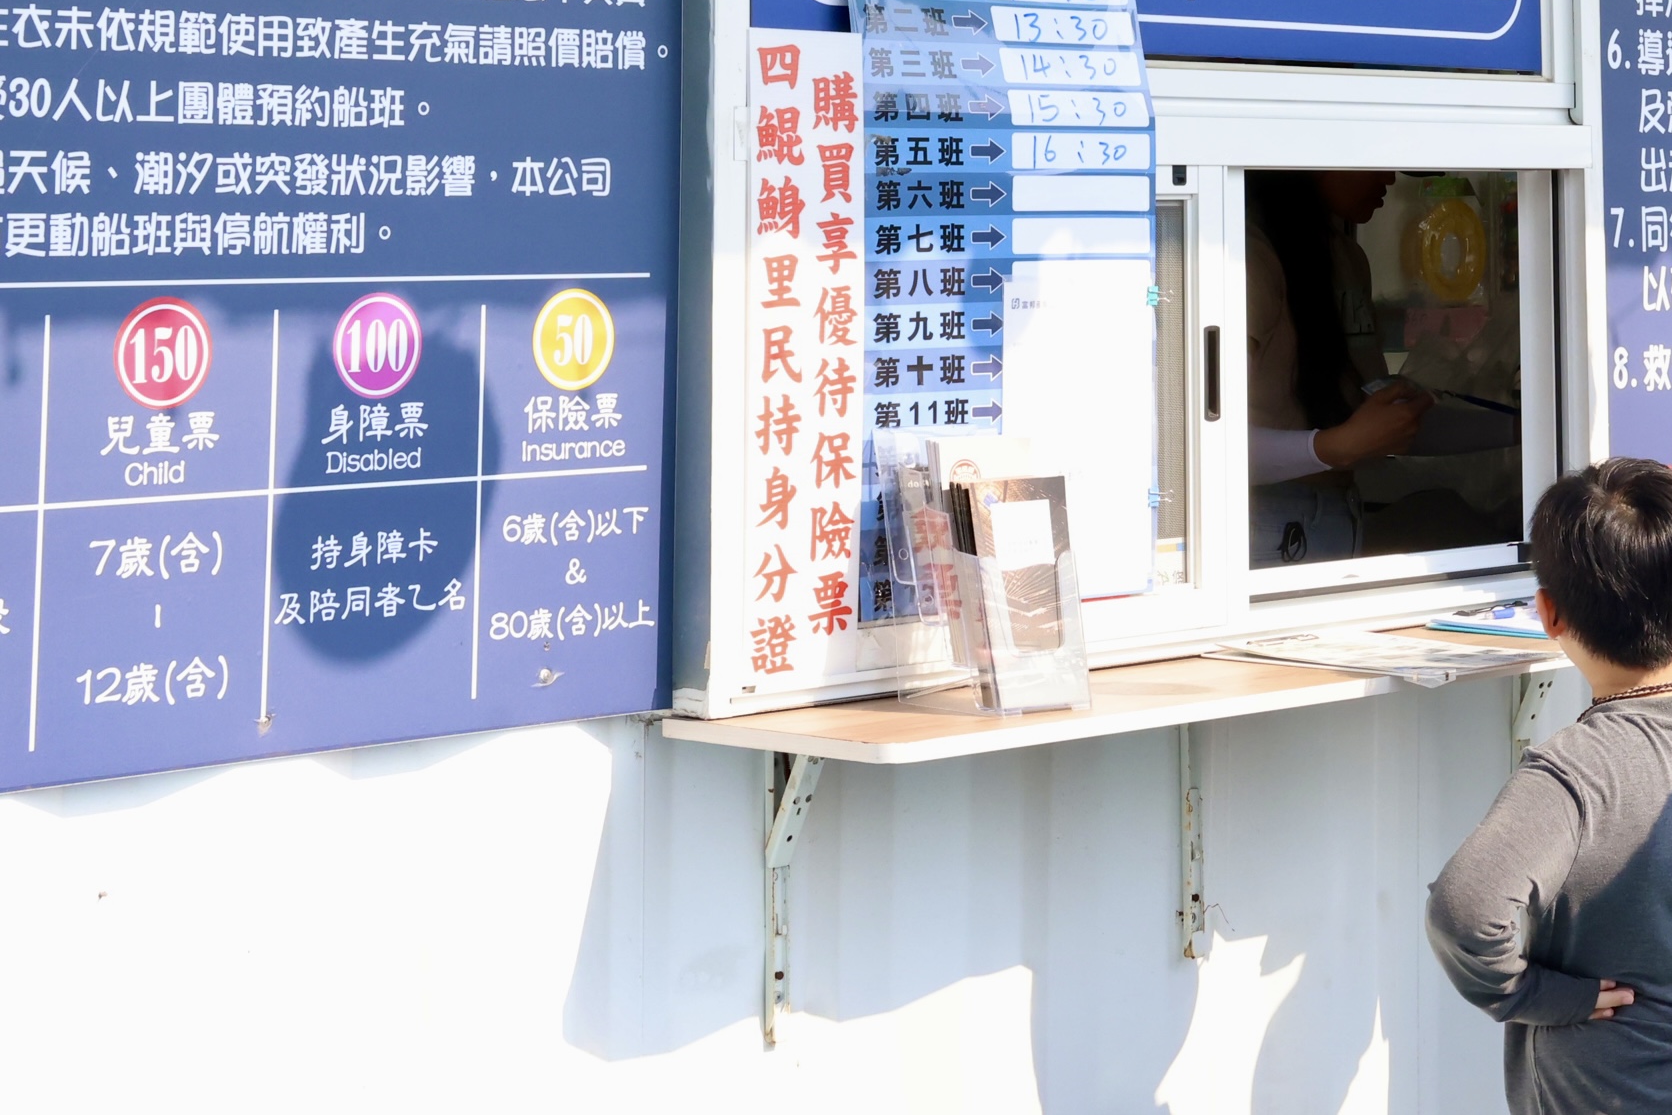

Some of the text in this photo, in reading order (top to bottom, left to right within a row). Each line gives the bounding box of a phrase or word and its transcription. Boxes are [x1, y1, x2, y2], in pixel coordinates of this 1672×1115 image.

[0, 3, 668, 71] 衣未依規範使用致產生充氣請照價賠償。
[863, 2, 950, 37] 第二班
[868, 46, 958, 80] 第三班
[0, 75, 430, 129] 30人以上團體預約船班。
[873, 90, 964, 123] 第四班
[873, 135, 965, 167] 第五班
[0, 149, 611, 198] 天候、潮汐或突發狀況影響，本公司
[875, 179, 966, 212] 第六班
[0, 211, 392, 258] 更動船班與停航權利。
[875, 222, 966, 256] 第七班
[873, 266, 966, 300] 第八班
[347, 318, 408, 374] 100
[553, 315, 594, 366] 50
[873, 310, 966, 344] 第九班
[129, 324, 197, 386] 150
[750, 43, 806, 676] 四鯤鯓里民持身分證
[806, 70, 859, 637] 購買享優待保險票
[873, 354, 966, 389] 第十班
[100, 410, 221, 459] 兒童票
[321, 401, 429, 447] 身障票
[523, 392, 624, 435] 保險票
[874, 397, 970, 430] 第11班
[326, 448, 422, 475] Disabled
[521, 437, 626, 464] Insurance
[124, 460, 186, 488] Child
[502, 506, 649, 545] 6歲(含)以下
[88, 530, 223, 582] 7歲(含)
[310, 528, 440, 572] 持身障卡
[565, 558, 588, 585] &
[274, 578, 467, 626] 及陪同者乙名
[489, 599, 656, 643] 80歲(含)以上
[76, 655, 228, 706] 12歲(含)
